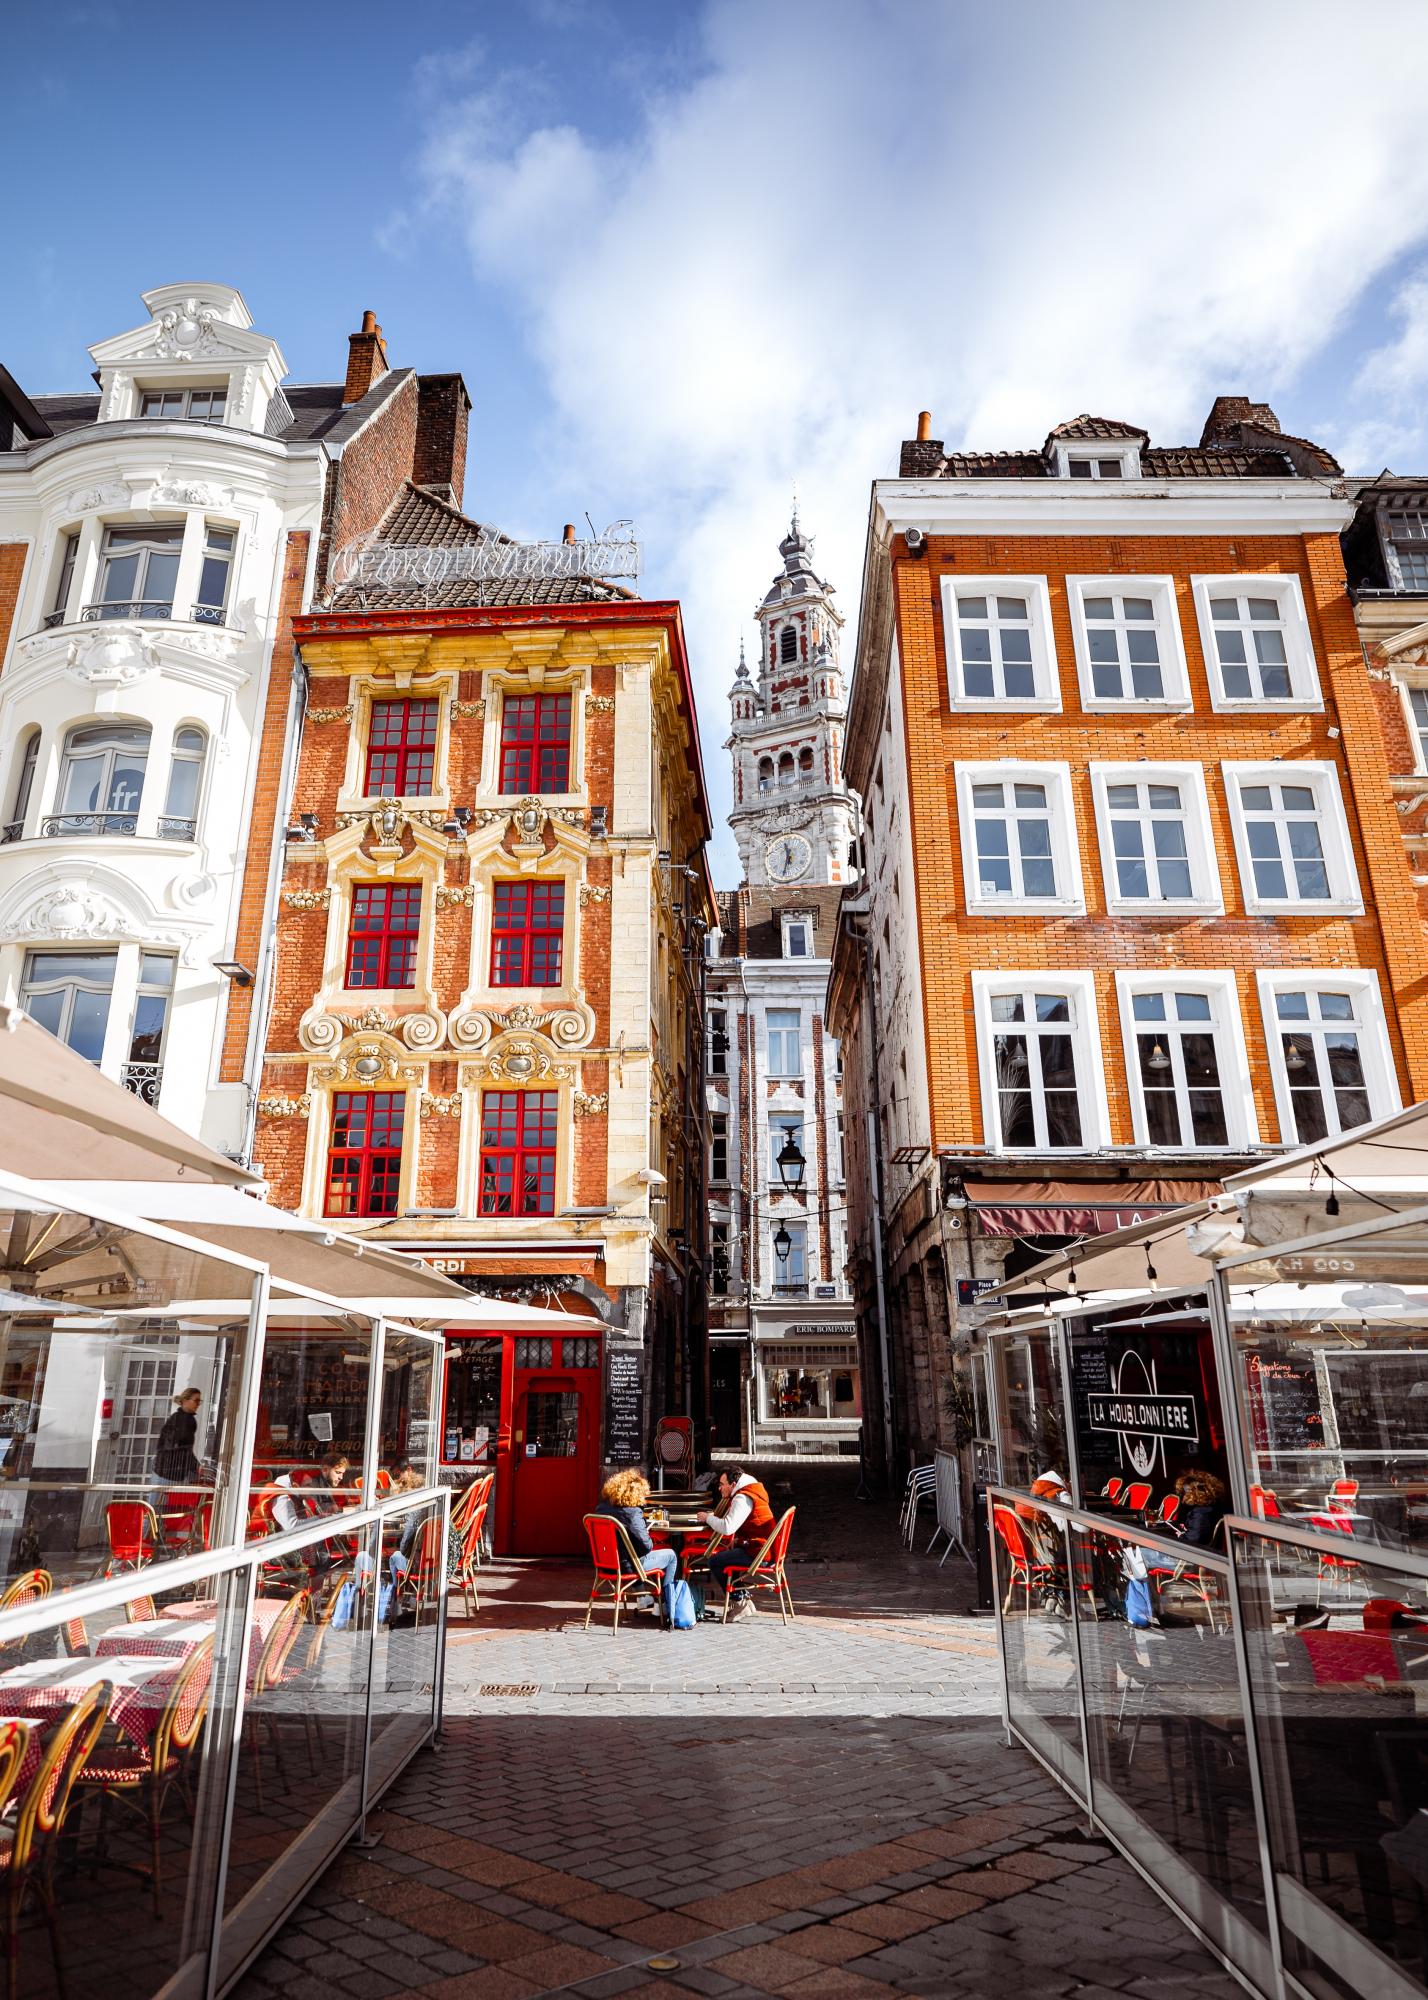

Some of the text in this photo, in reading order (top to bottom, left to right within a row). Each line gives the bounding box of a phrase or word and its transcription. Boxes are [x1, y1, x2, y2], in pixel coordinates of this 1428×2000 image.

[433, 1260, 465, 1272] RDI
[796, 1325, 856, 1333] ERIC BOMPARD
[1093, 1403, 1190, 1429] LA HOUBLONNIERE
